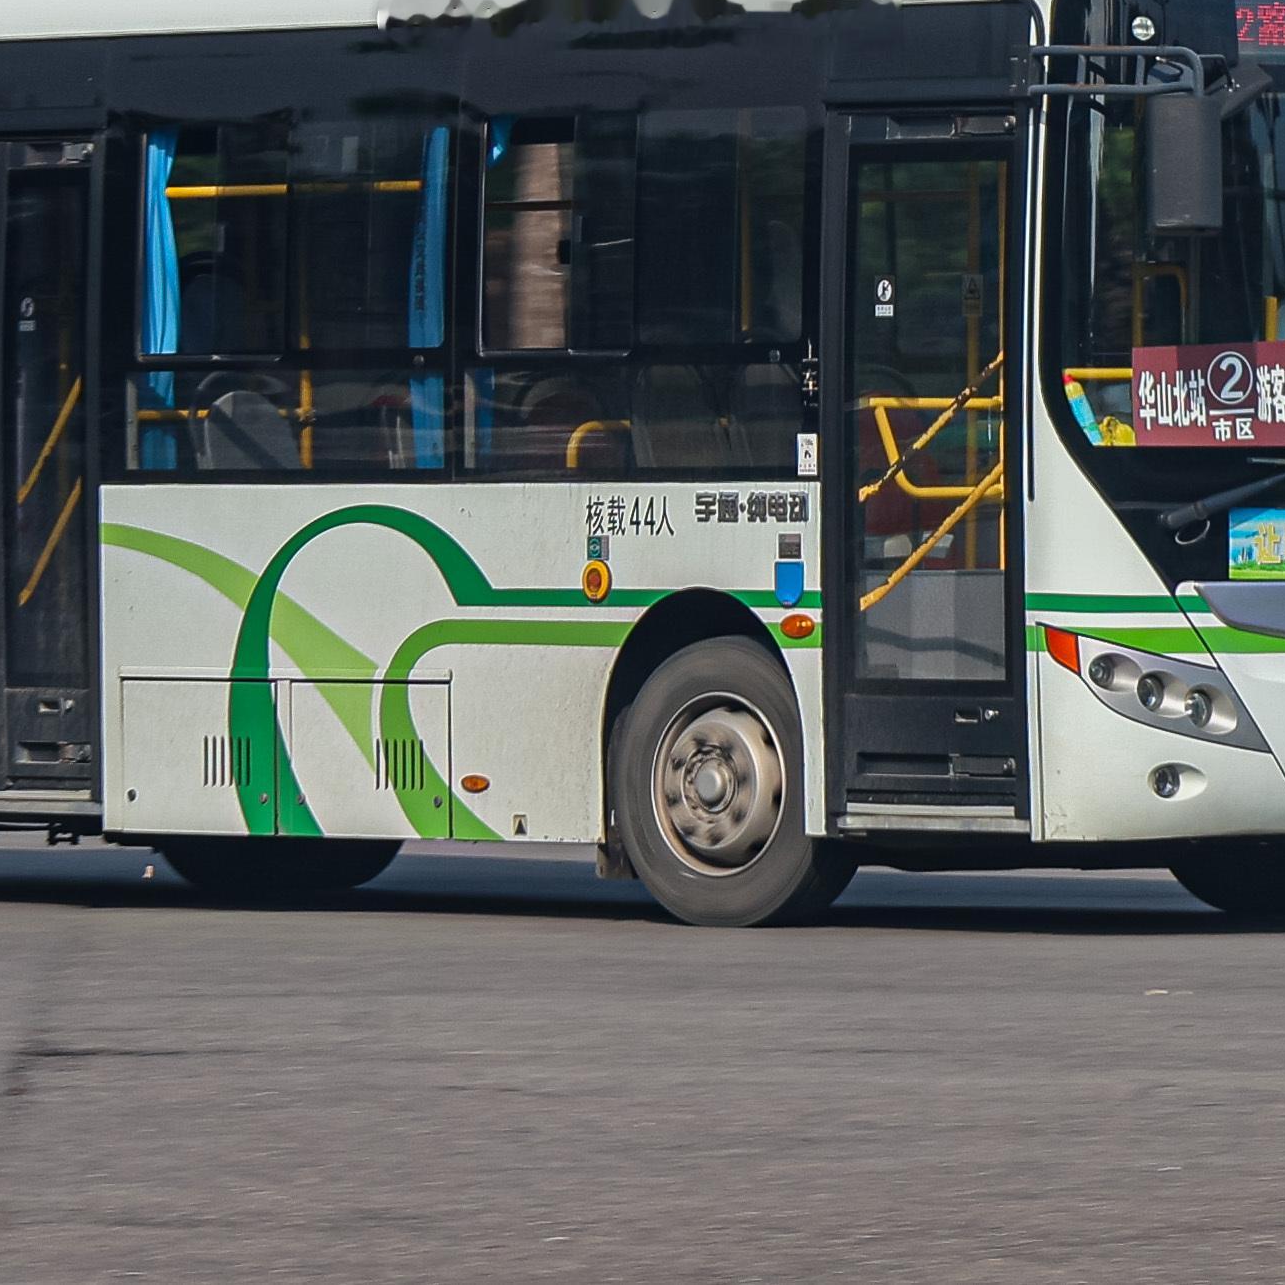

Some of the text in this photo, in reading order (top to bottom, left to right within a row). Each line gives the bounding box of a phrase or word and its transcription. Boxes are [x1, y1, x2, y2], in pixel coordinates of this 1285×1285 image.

[1138, 368, 1207, 431] 华山北站
[1217, 355, 1245, 401] 2
[1211, 417, 1256, 442] 市区
[585, 494, 675, 536] 核载44人
